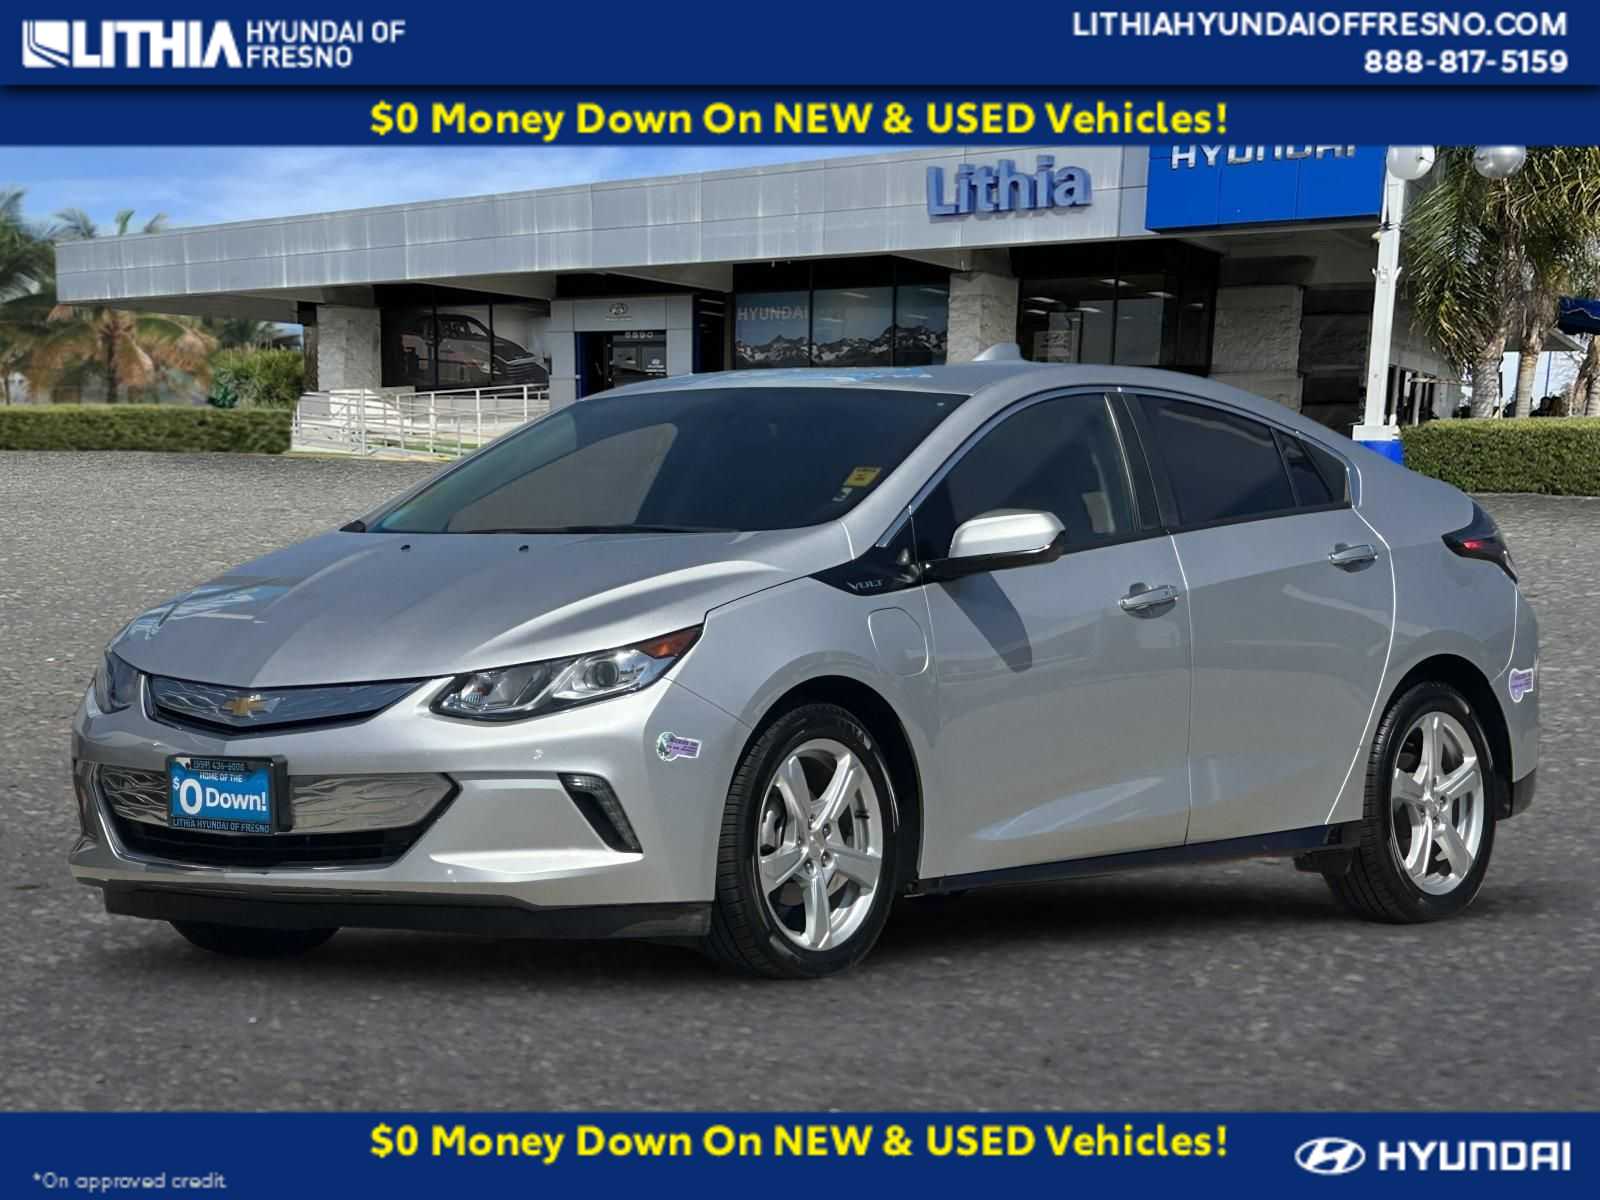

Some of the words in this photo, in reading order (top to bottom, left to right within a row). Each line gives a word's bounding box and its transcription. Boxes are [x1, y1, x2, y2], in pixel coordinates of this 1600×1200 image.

[926, 154, 1092, 216] Lithia
[737, 305, 809, 321] HYUNDAI
[199, 772, 218, 781] HOME
[219, 774, 229, 782] OF
[230, 774, 243, 783] THE
[172, 776, 203, 815] $0
[205, 787, 268, 812] Down!
[173, 819, 196, 829] LITHIA
[197, 820, 229, 831] HYUNDAI
[229, 822, 240, 831] OF
[241, 823, 271, 834] FRESNO
